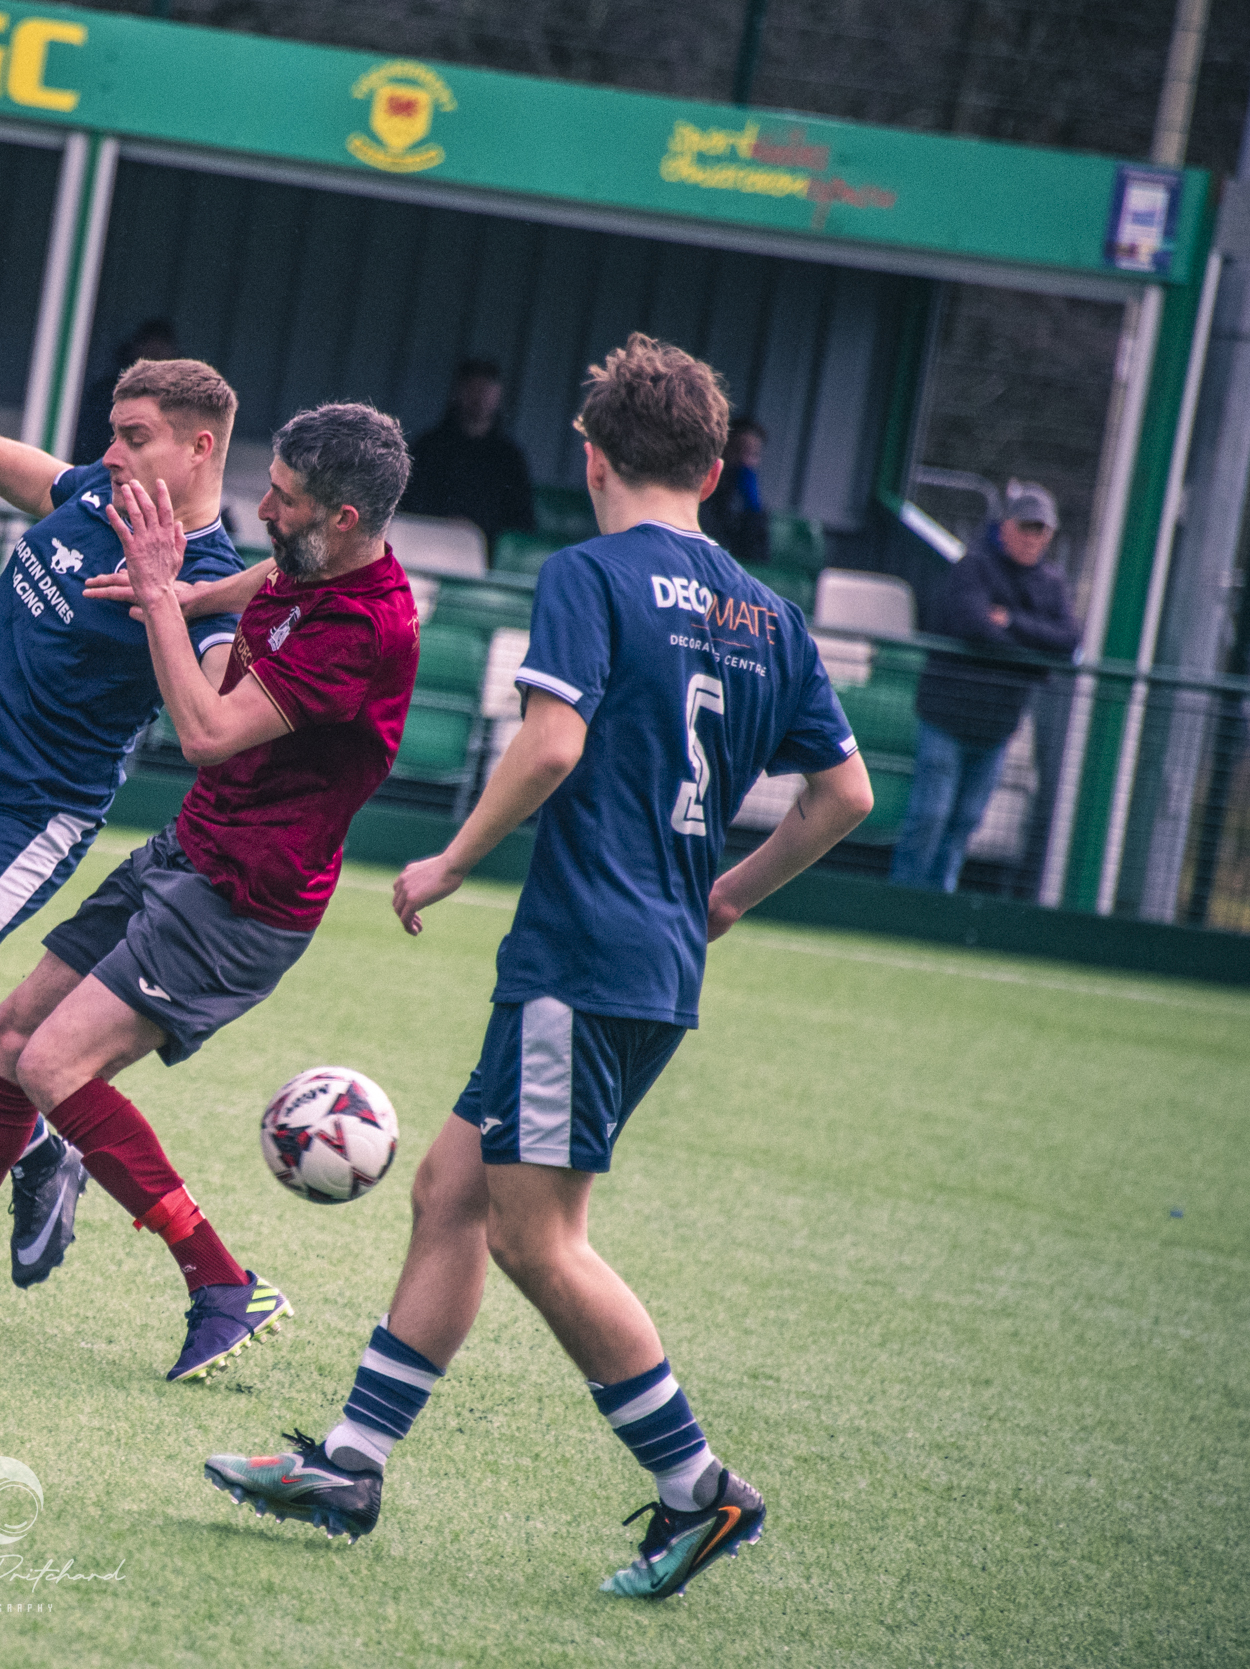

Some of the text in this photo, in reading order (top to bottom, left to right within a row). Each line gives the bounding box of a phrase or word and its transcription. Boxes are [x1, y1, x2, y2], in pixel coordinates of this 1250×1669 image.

[12, 565, 45, 618] ACING
[38, 576, 74, 625] DAVIES
[724, 654, 767, 677] CENTRE
[671, 673, 725, 837] 5
